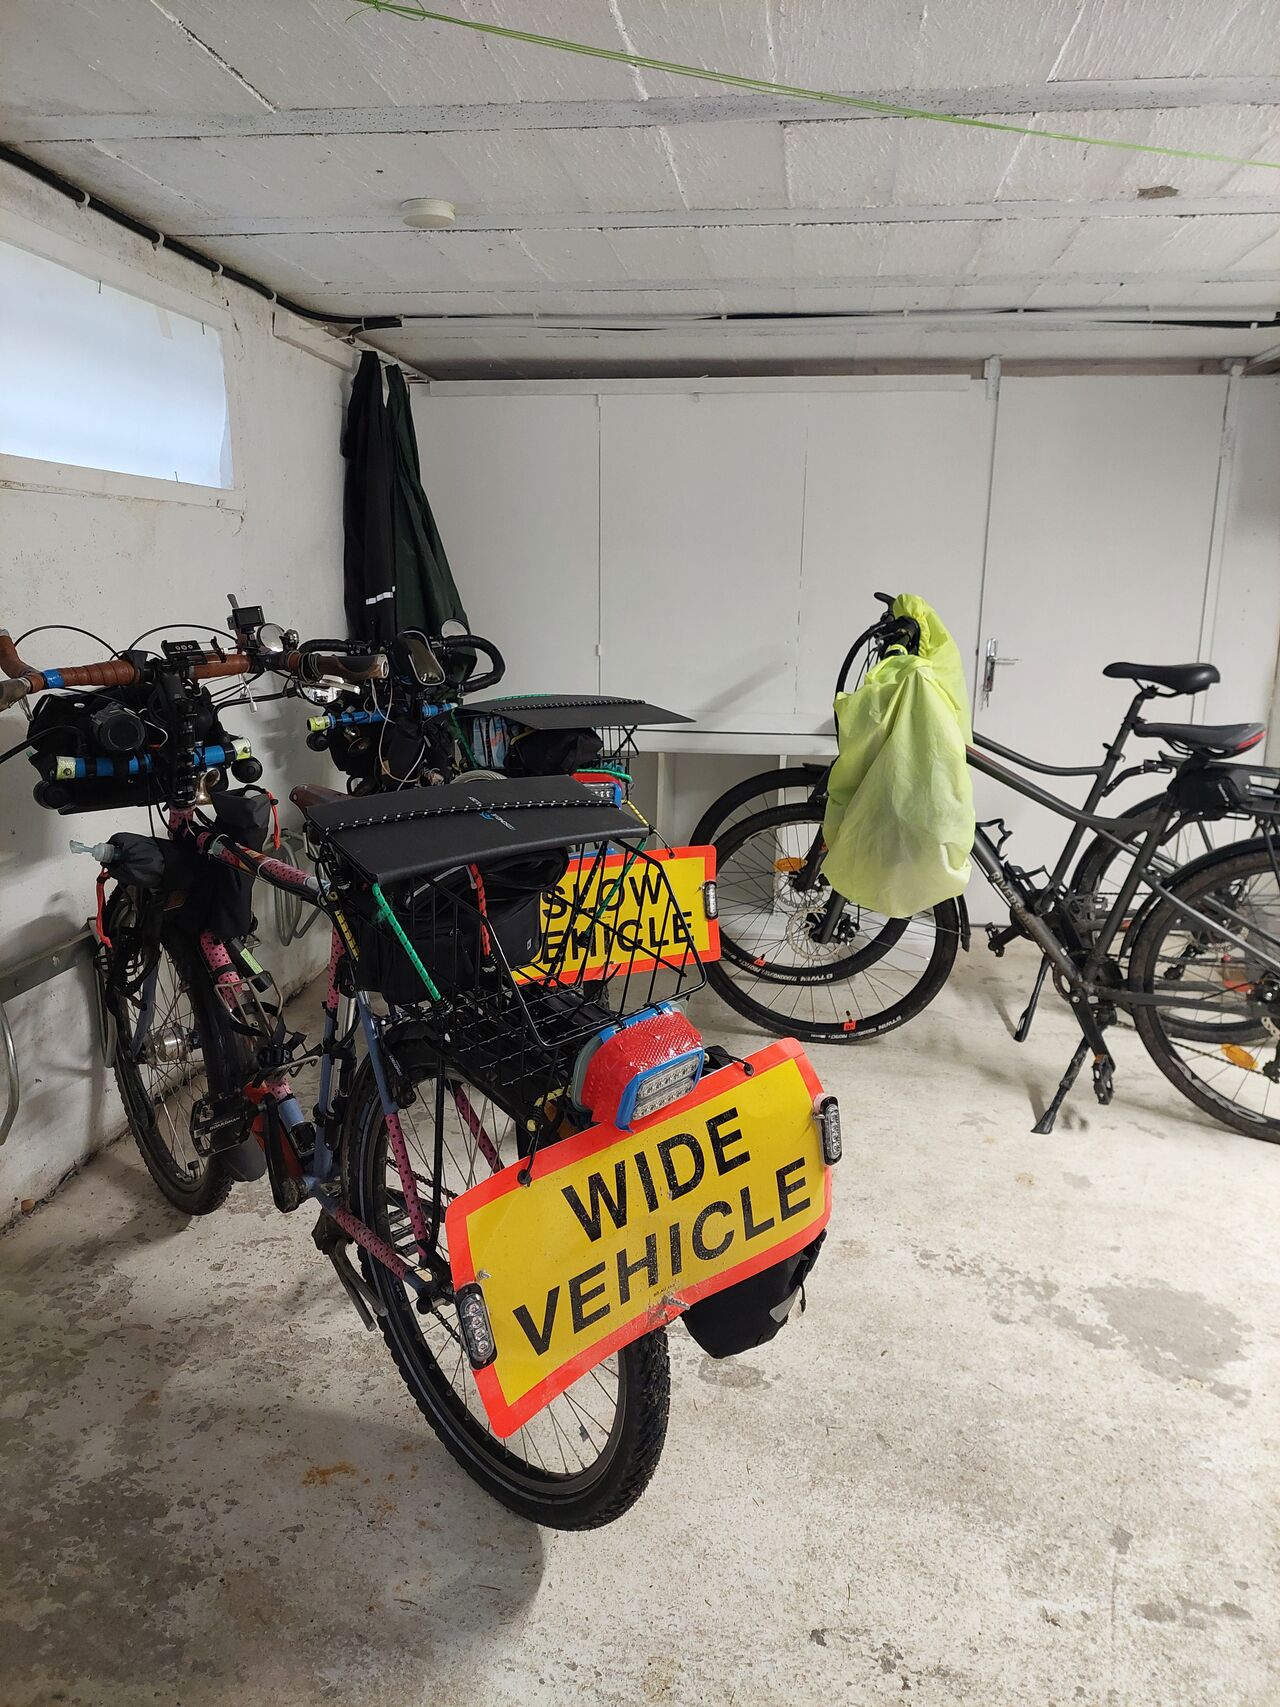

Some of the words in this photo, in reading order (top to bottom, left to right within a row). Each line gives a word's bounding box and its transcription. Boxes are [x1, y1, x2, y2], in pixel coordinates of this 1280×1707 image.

[542, 911, 695, 965] EHICLE
[561, 1106, 751, 1243] WIDE
[512, 1156, 811, 1357] VEHICLE
